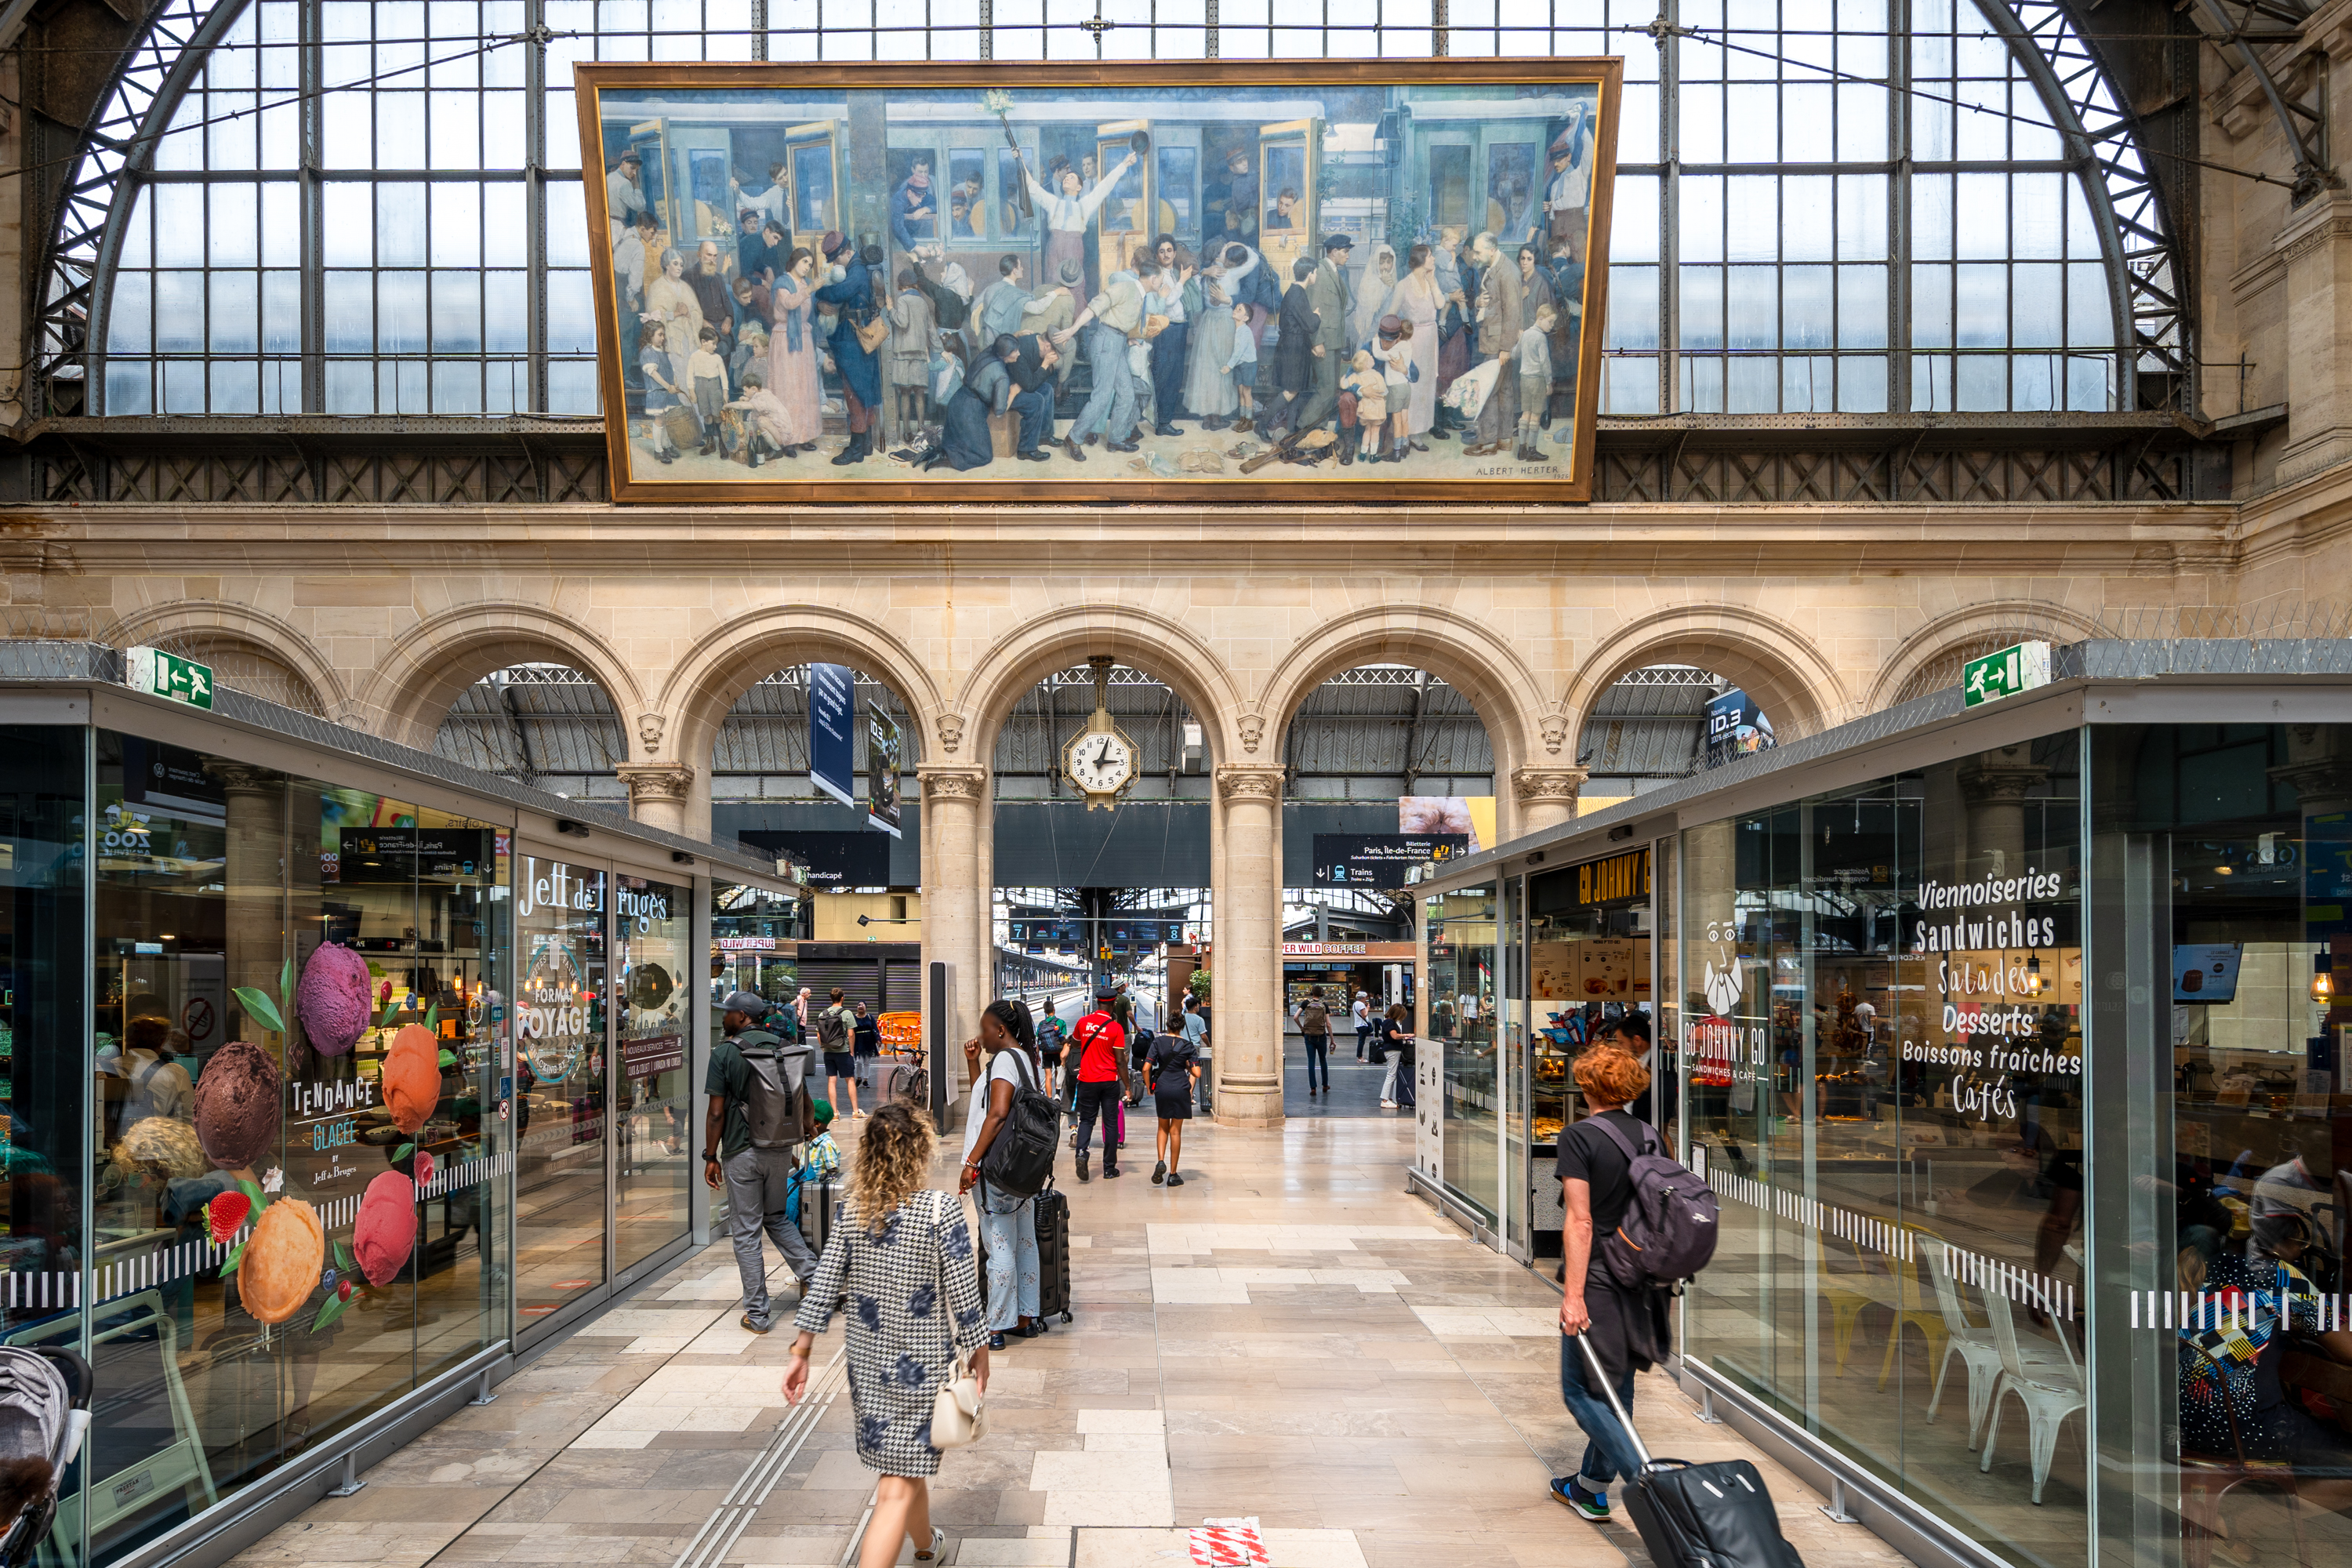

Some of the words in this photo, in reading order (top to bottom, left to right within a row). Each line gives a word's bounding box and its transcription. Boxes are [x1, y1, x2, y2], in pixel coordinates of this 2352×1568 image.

[1475, 467, 1513, 476] ALBERT
[1521, 466, 1559, 474] HERTER
[1711, 705, 1727, 717] Nouvelle
[1711, 708, 1741, 735] ID.3
[870, 719, 883, 742] ID.3
[1711, 734, 1722, 744] 100%
[1364, 847, 1384, 855] Paris,
[1384, 845, 1431, 855] Île-de-France
[519, 856, 572, 916] Jeff
[574, 878, 593, 911] de
[807, 871, 843, 880] handicapé
[1579, 864, 1592, 904] GO
[1594, 852, 1639, 902] JOHNNY
[1918, 866, 2061, 910] Viennoiseries
[1014, 929, 1022, 938] 7
[1171, 930, 1178, 939] 8
[1916, 910, 2054, 953] Sandwiches
[1298, 944, 1321, 953] WILD
[1323, 943, 1366, 954] COFFEE
[1937, 958, 2029, 996] Salades
[535, 988, 573, 1004] FORMAT
[517, 1007, 591, 1040] VOYAGE
[1942, 1005, 2033, 1036] Desserts
[627, 1044, 648, 1054] NOUVEAUX
[647, 1042, 664, 1052] SERVICES
[1684, 1022, 1696, 1057] GO
[1700, 1023, 1744, 1063] JOHNNY
[1751, 1027, 1765, 1066] GO
[1903, 1040, 1983, 1068] Boissons
[1990, 1044, 2082, 1075] fraîches
[1692, 1063, 1731, 1077] SANDWICHES
[1733, 1069, 1737, 1079] &
[1738, 1070, 1756, 1082] CAFÉ
[292, 1076, 373, 1116] TENDANCE
[1952, 1074, 2016, 1121] Cafés
[314, 1117, 357, 1152] GLACÉE
[332, 1154, 339, 1163] BY
[313, 1170, 328, 1185] Jeff
[333, 1165, 357, 1178] Bruges
[116, 1478, 140, 1494] PRESTAR
